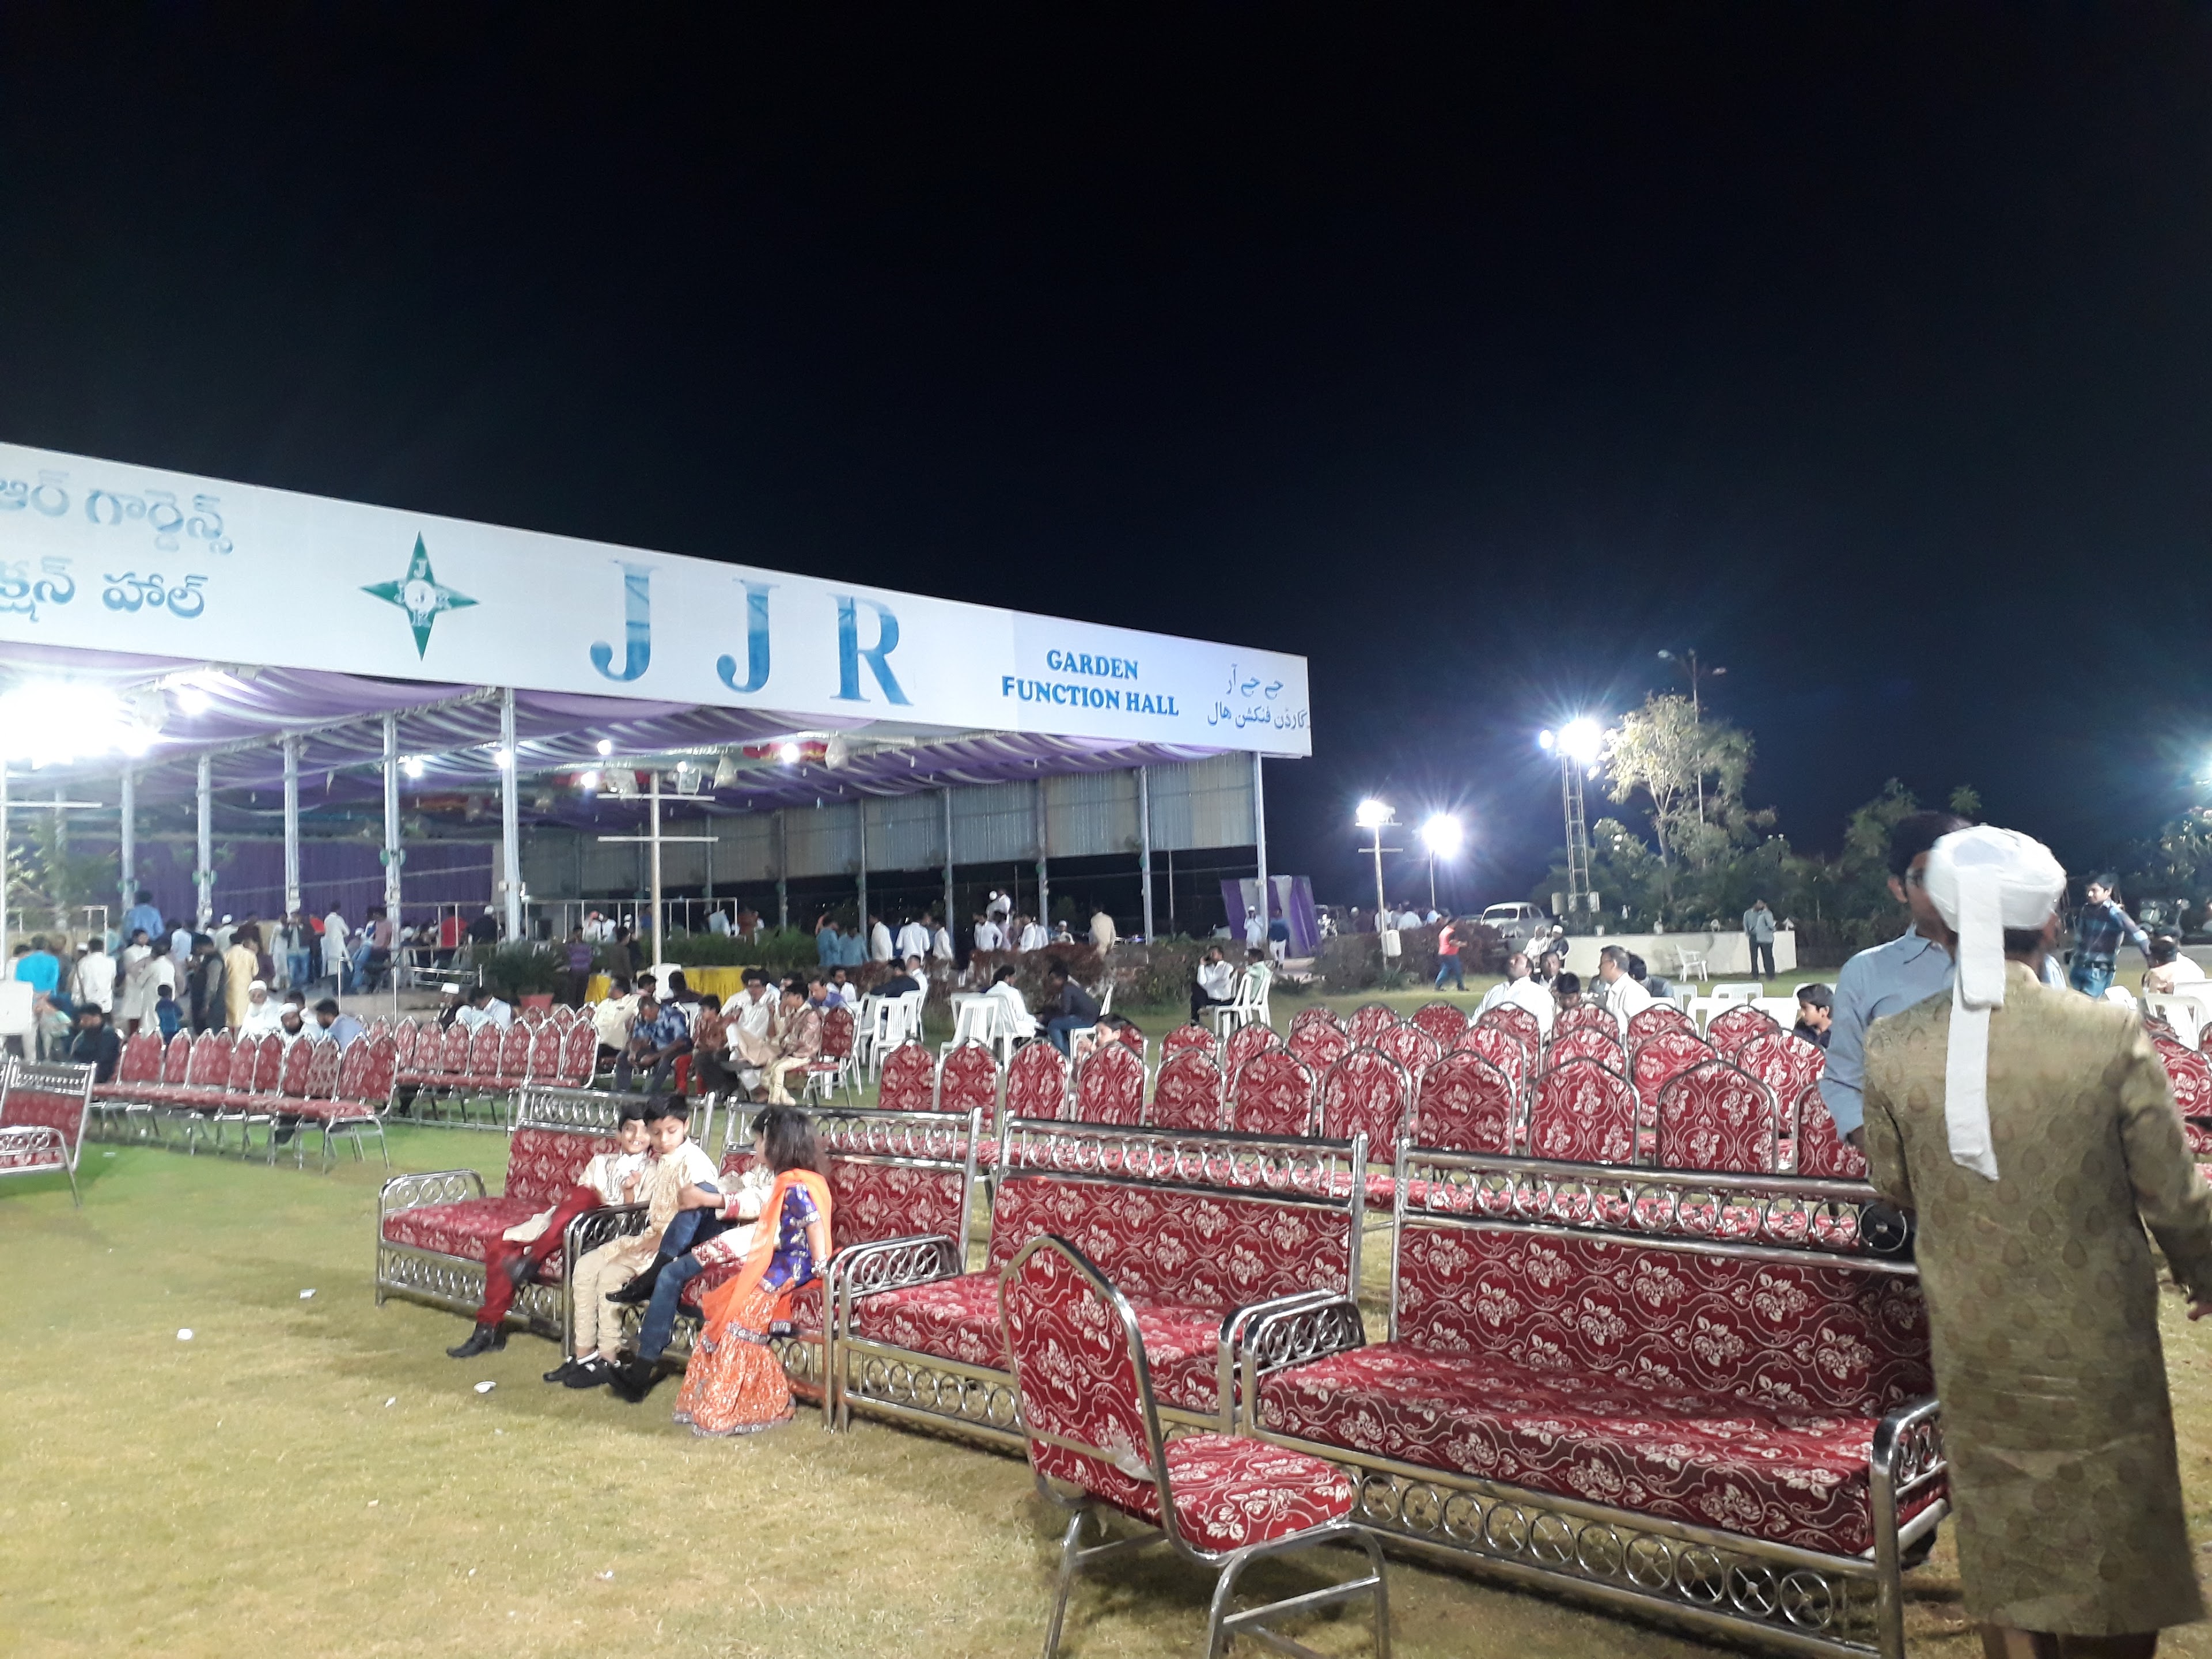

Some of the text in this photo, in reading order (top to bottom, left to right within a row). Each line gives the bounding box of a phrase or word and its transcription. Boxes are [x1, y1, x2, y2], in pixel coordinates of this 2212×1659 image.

[102, 571, 208, 619] హాల్
[1047, 650, 1139, 680] GARDEN
[1002, 676, 1180, 717] FUNCTION HALL
